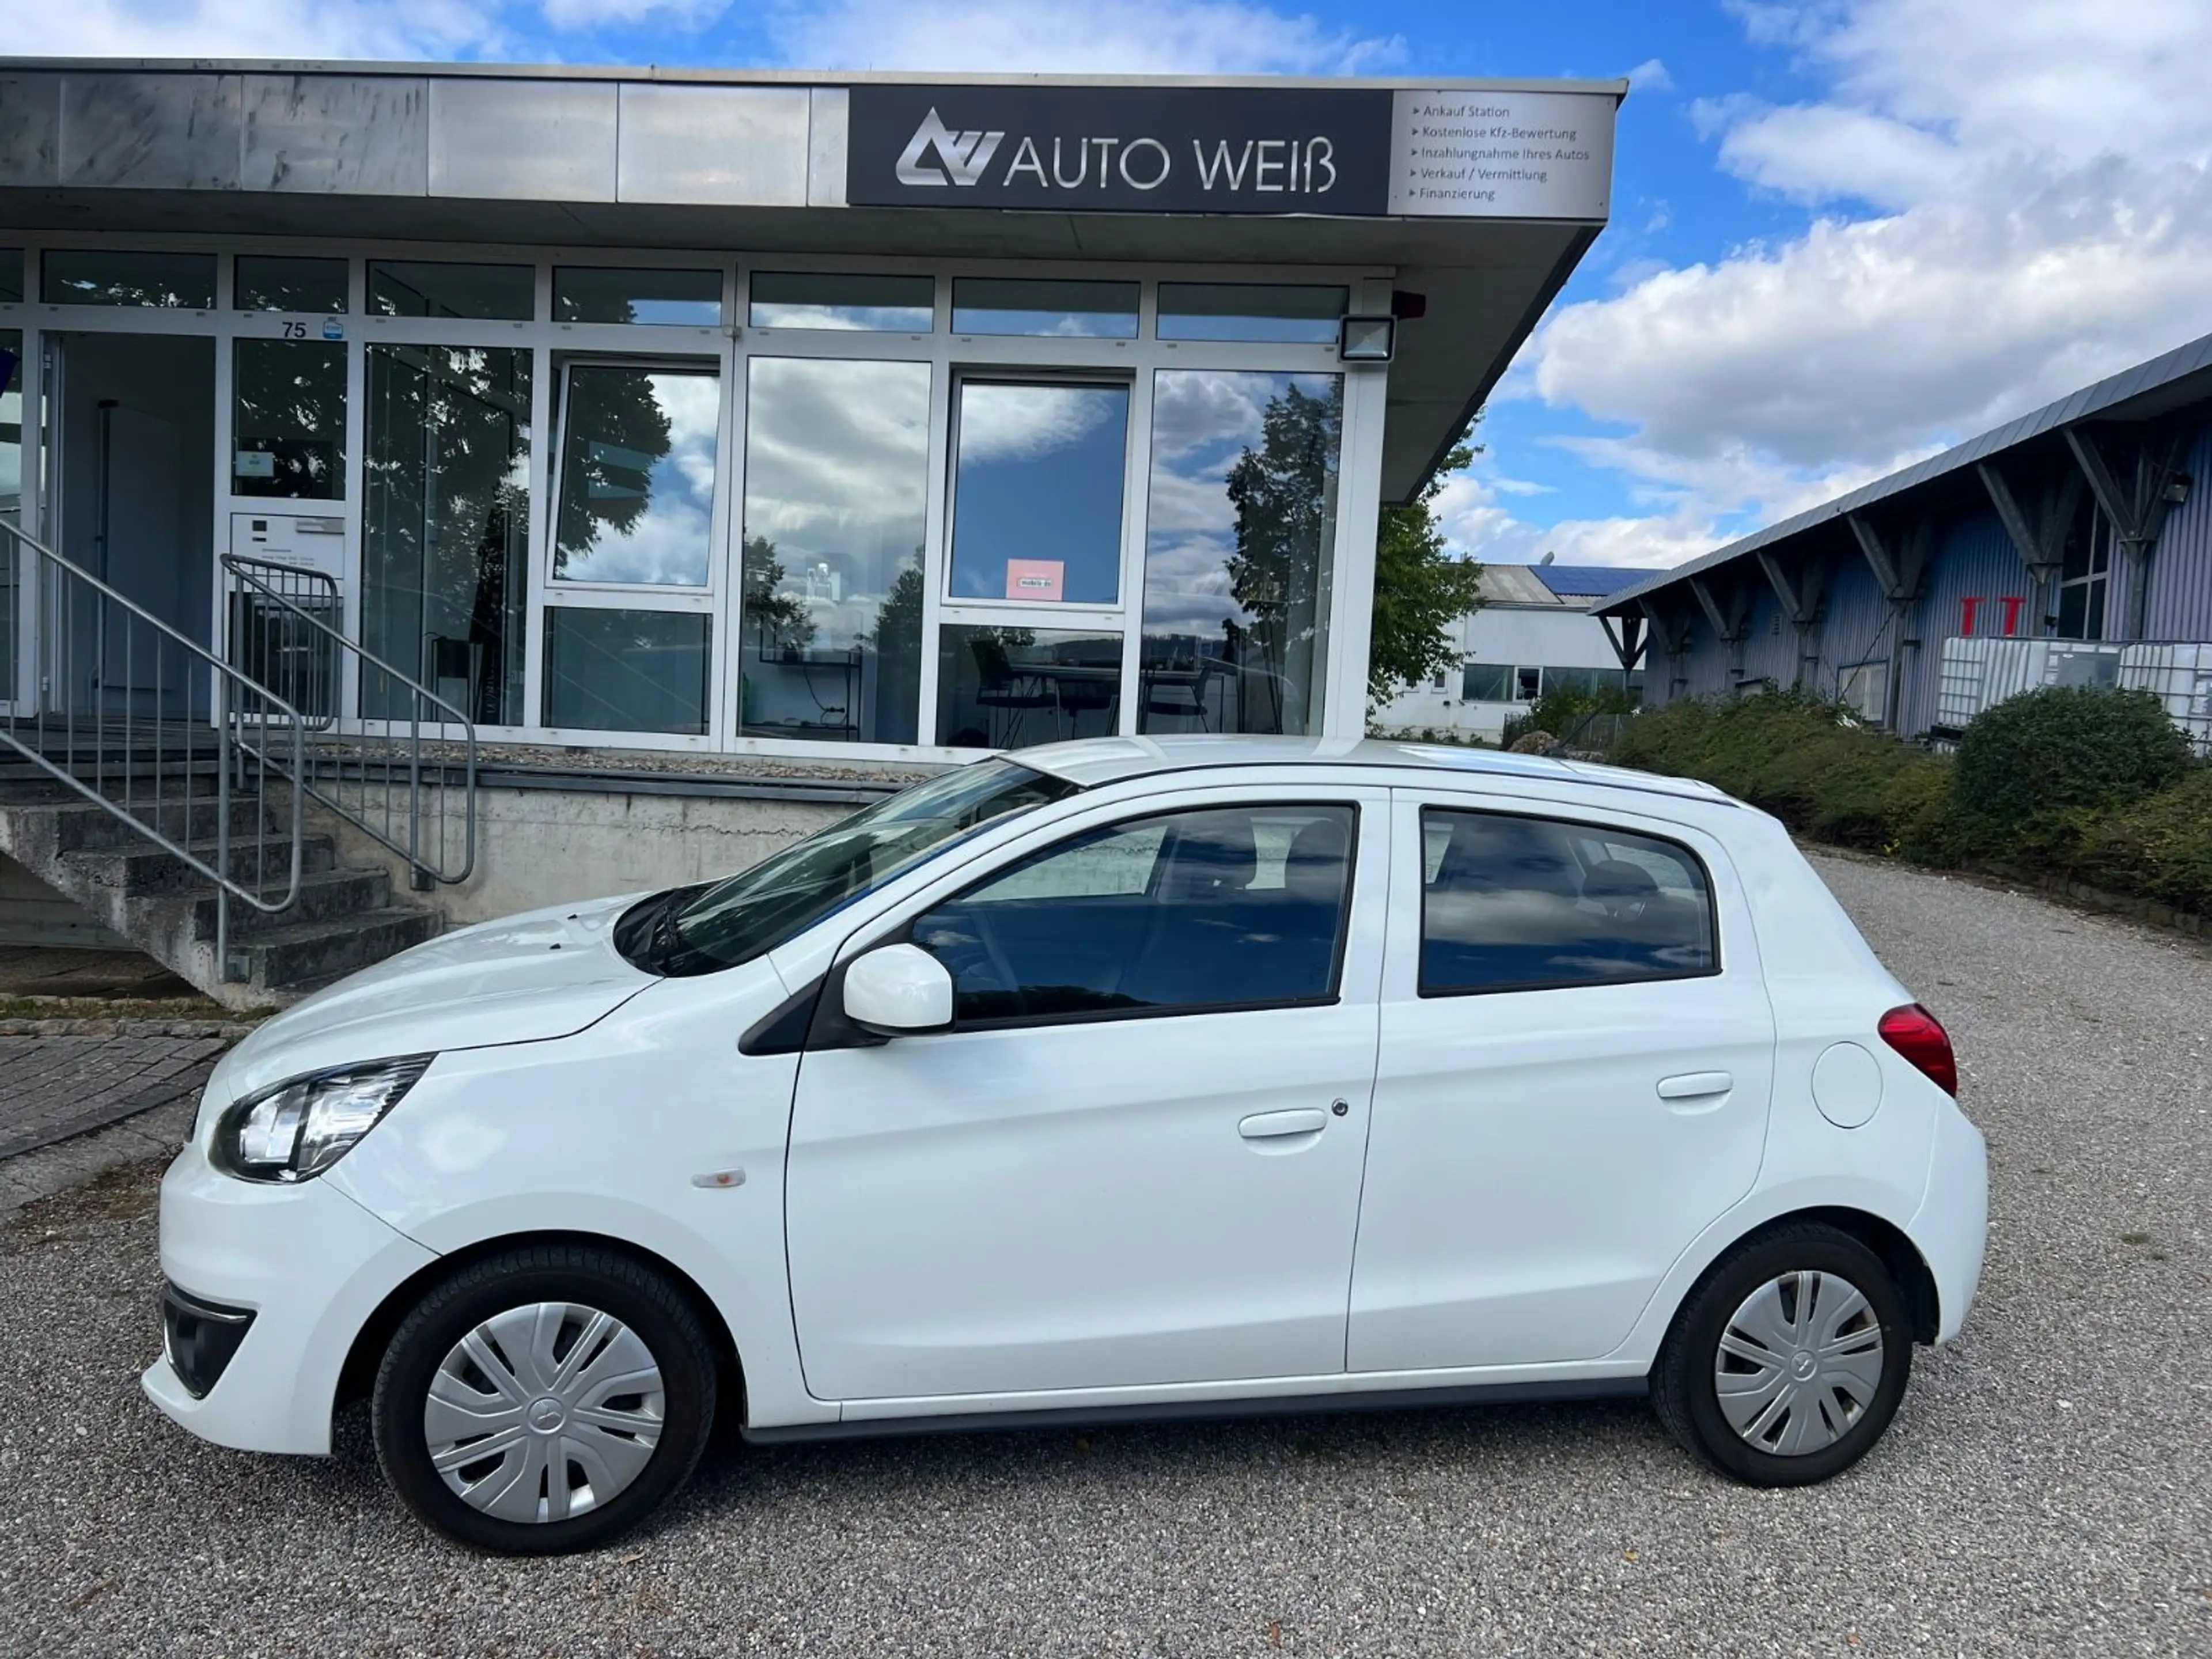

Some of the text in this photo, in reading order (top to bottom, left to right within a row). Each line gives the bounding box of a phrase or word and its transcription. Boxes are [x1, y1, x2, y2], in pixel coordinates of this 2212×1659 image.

[1423, 105, 1510, 118] Ankauf Station
[1422, 126, 1577, 142] Kostenlose Kfz-Bewertung
[1422, 147, 1589, 161] Inzahlungnahme Ihres Autos
[1003, 136, 1171, 190] AUTO
[1193, 137, 1336, 193] WEIß
[1421, 168, 1465, 179] Verkauf
[1478, 168, 1548, 183] Vermittlung
[1419, 187, 1495, 202] Finanzierung
[282, 321, 306, 338] 75
